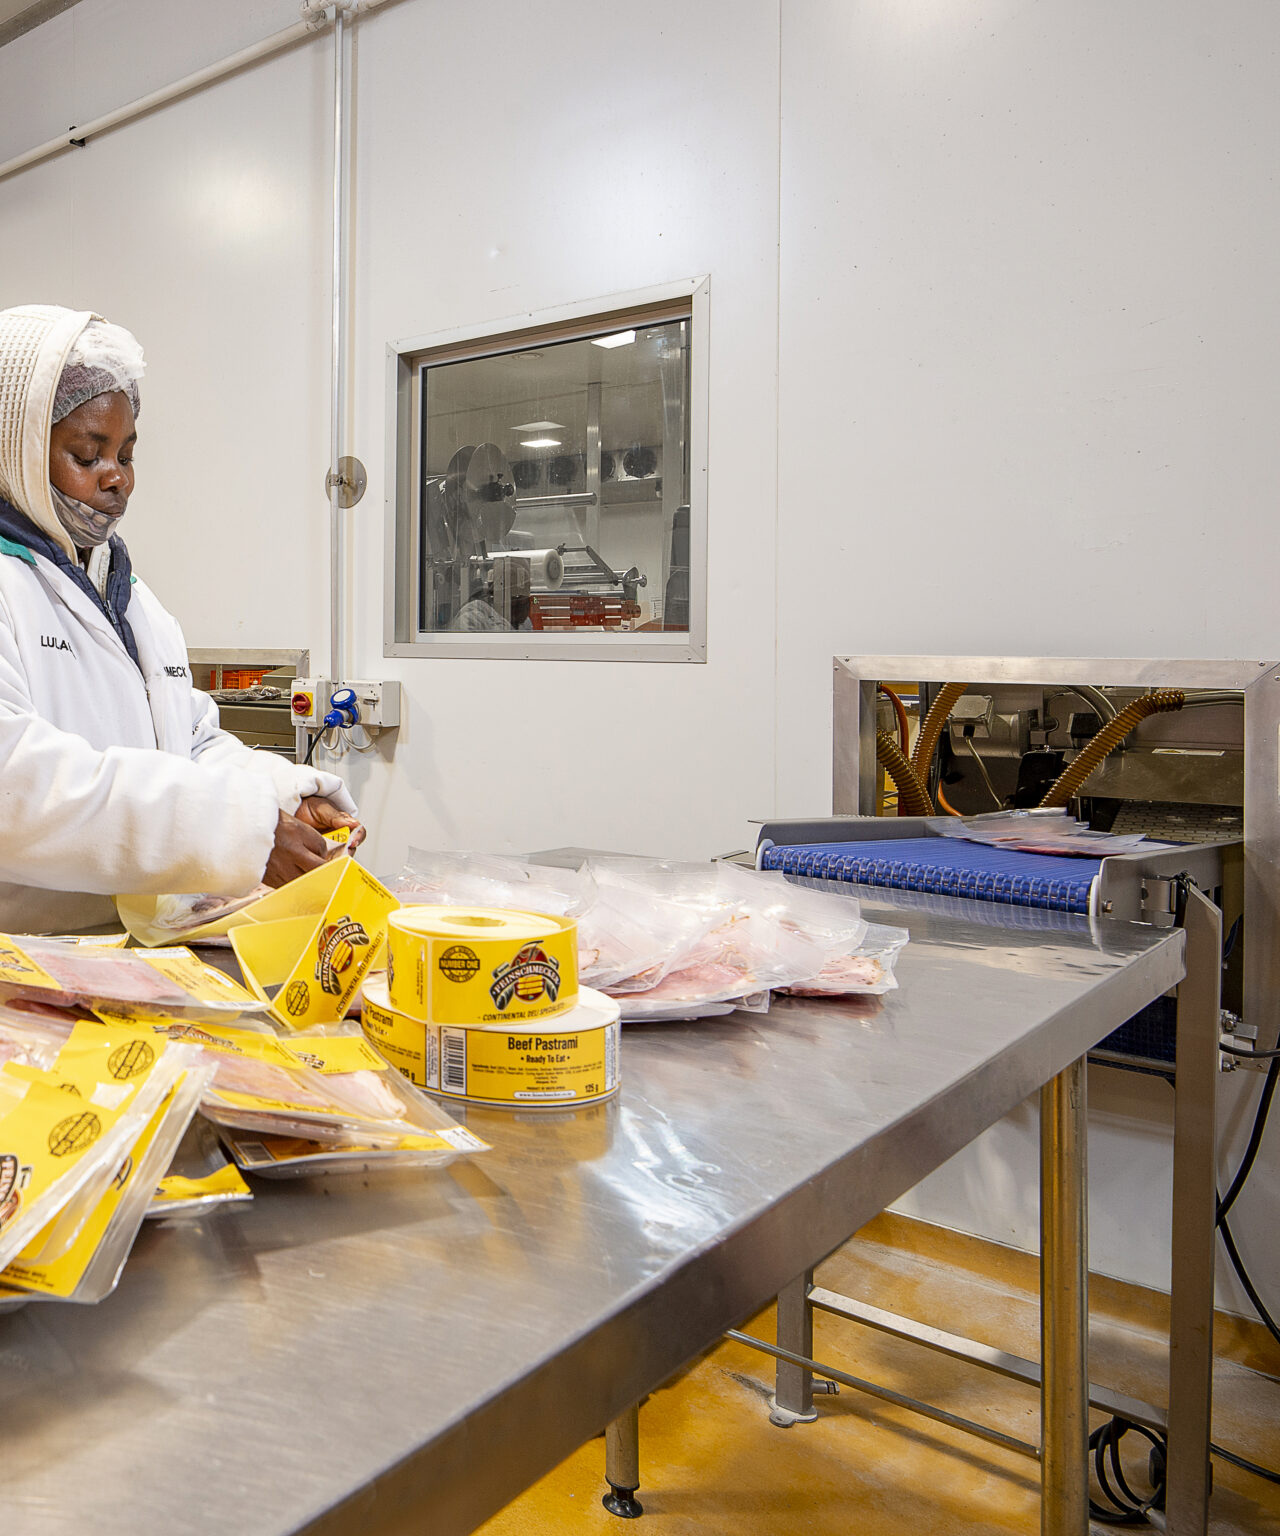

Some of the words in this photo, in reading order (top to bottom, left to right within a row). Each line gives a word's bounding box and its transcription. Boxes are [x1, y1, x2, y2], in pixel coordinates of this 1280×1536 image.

[322, 923, 361, 988] FEINSCHMECKER
[494, 964, 561, 994] FEINSCHMECKER
[336, 974, 360, 1014] CONTINENTAL
[482, 1011, 526, 1022] CONTINENTAL
[527, 1009, 539, 1018] DELI
[508, 1036, 533, 1050] Beef
[535, 1035, 579, 1050] Pastrami
[526, 1055, 546, 1065] Ready
[547, 1054, 555, 1063] To
[555, 1054, 566, 1063] Eat
[585, 1084, 594, 1093] 125
